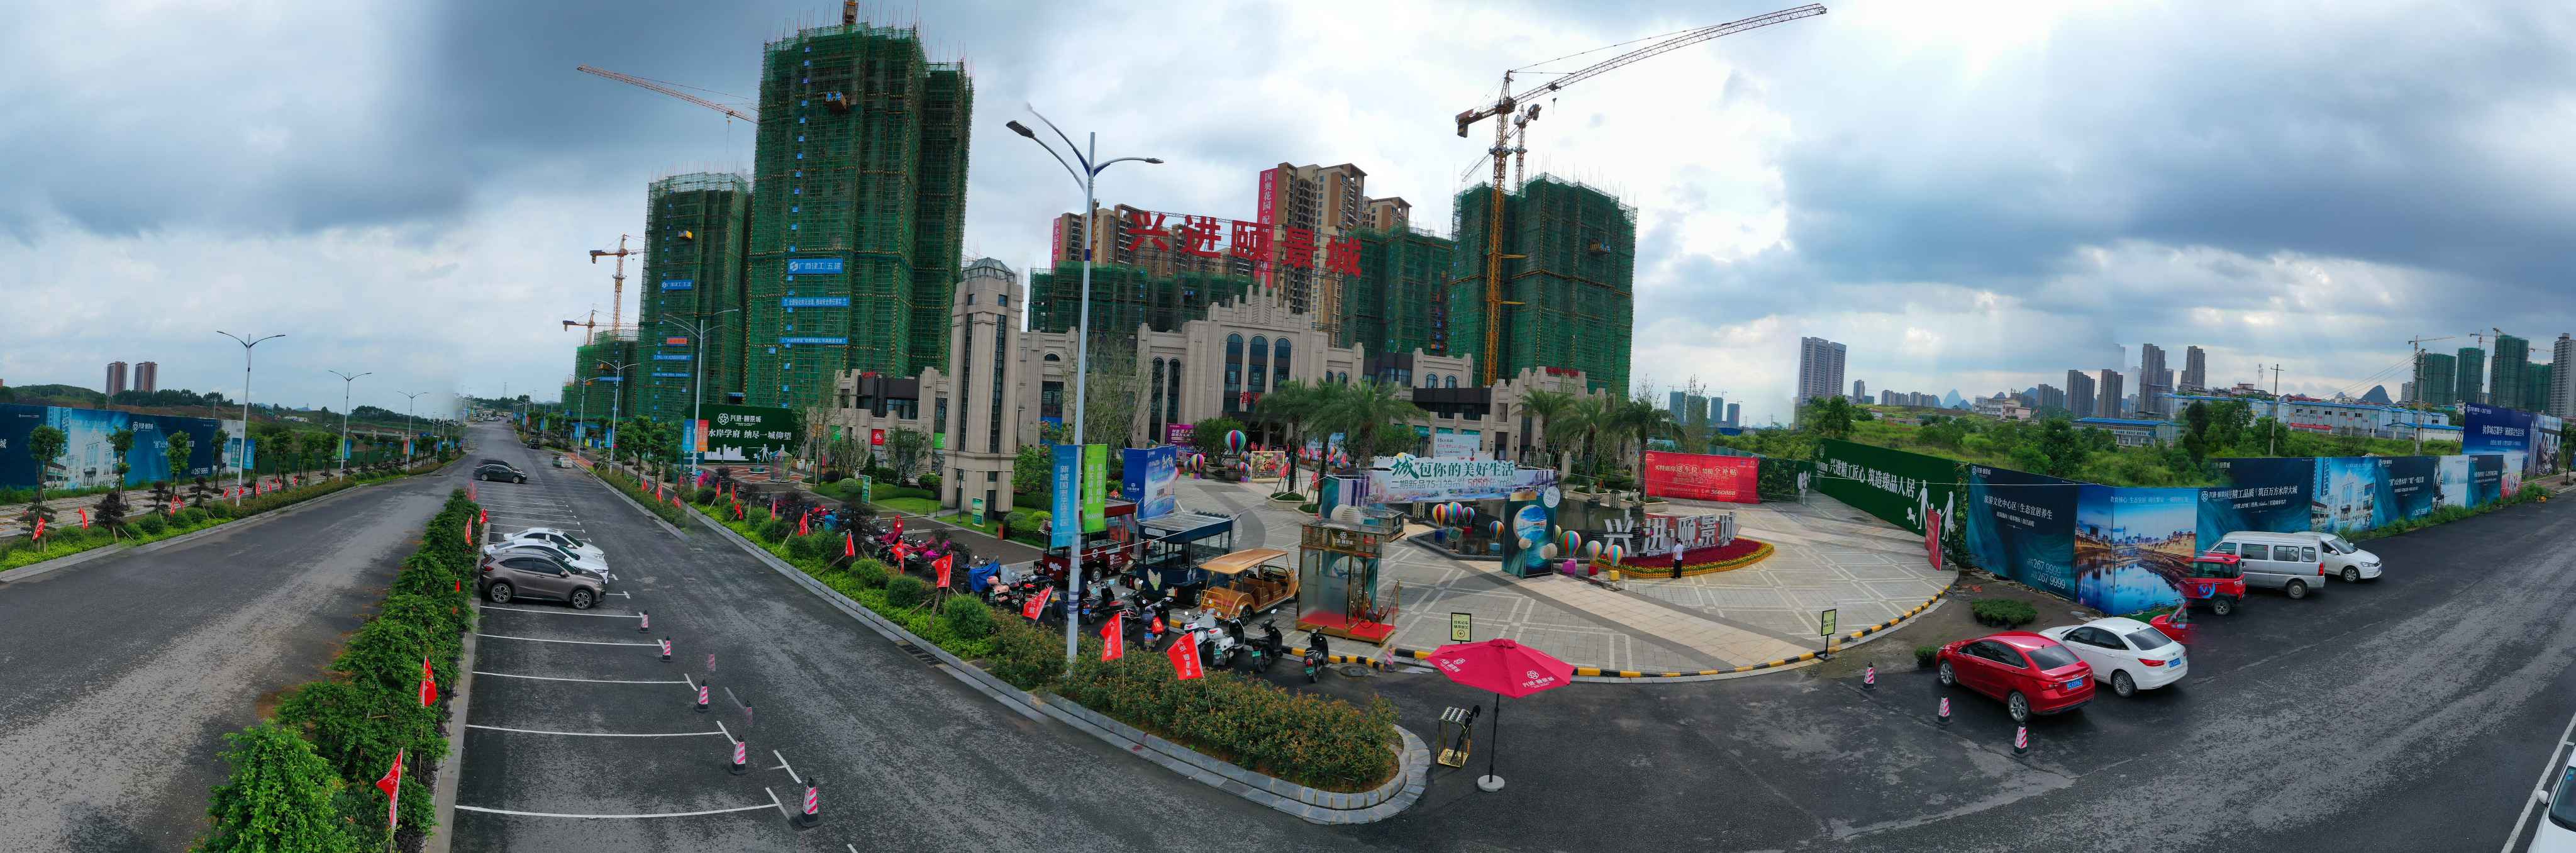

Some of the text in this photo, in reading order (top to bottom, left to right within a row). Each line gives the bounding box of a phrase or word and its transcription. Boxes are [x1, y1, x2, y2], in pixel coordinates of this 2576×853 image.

[1127, 211, 1362, 279] 兴进颐景城
[709, 429, 741, 438] 水岸学府
[744, 430, 792, 440] 纳尽一城仰望
[1829, 458, 1916, 499] 兴进精工匠心 筑造臻品人居
[2020, 503, 2053, 520] 生态宜居养生
[2038, 572, 2065, 589] 267 9999
